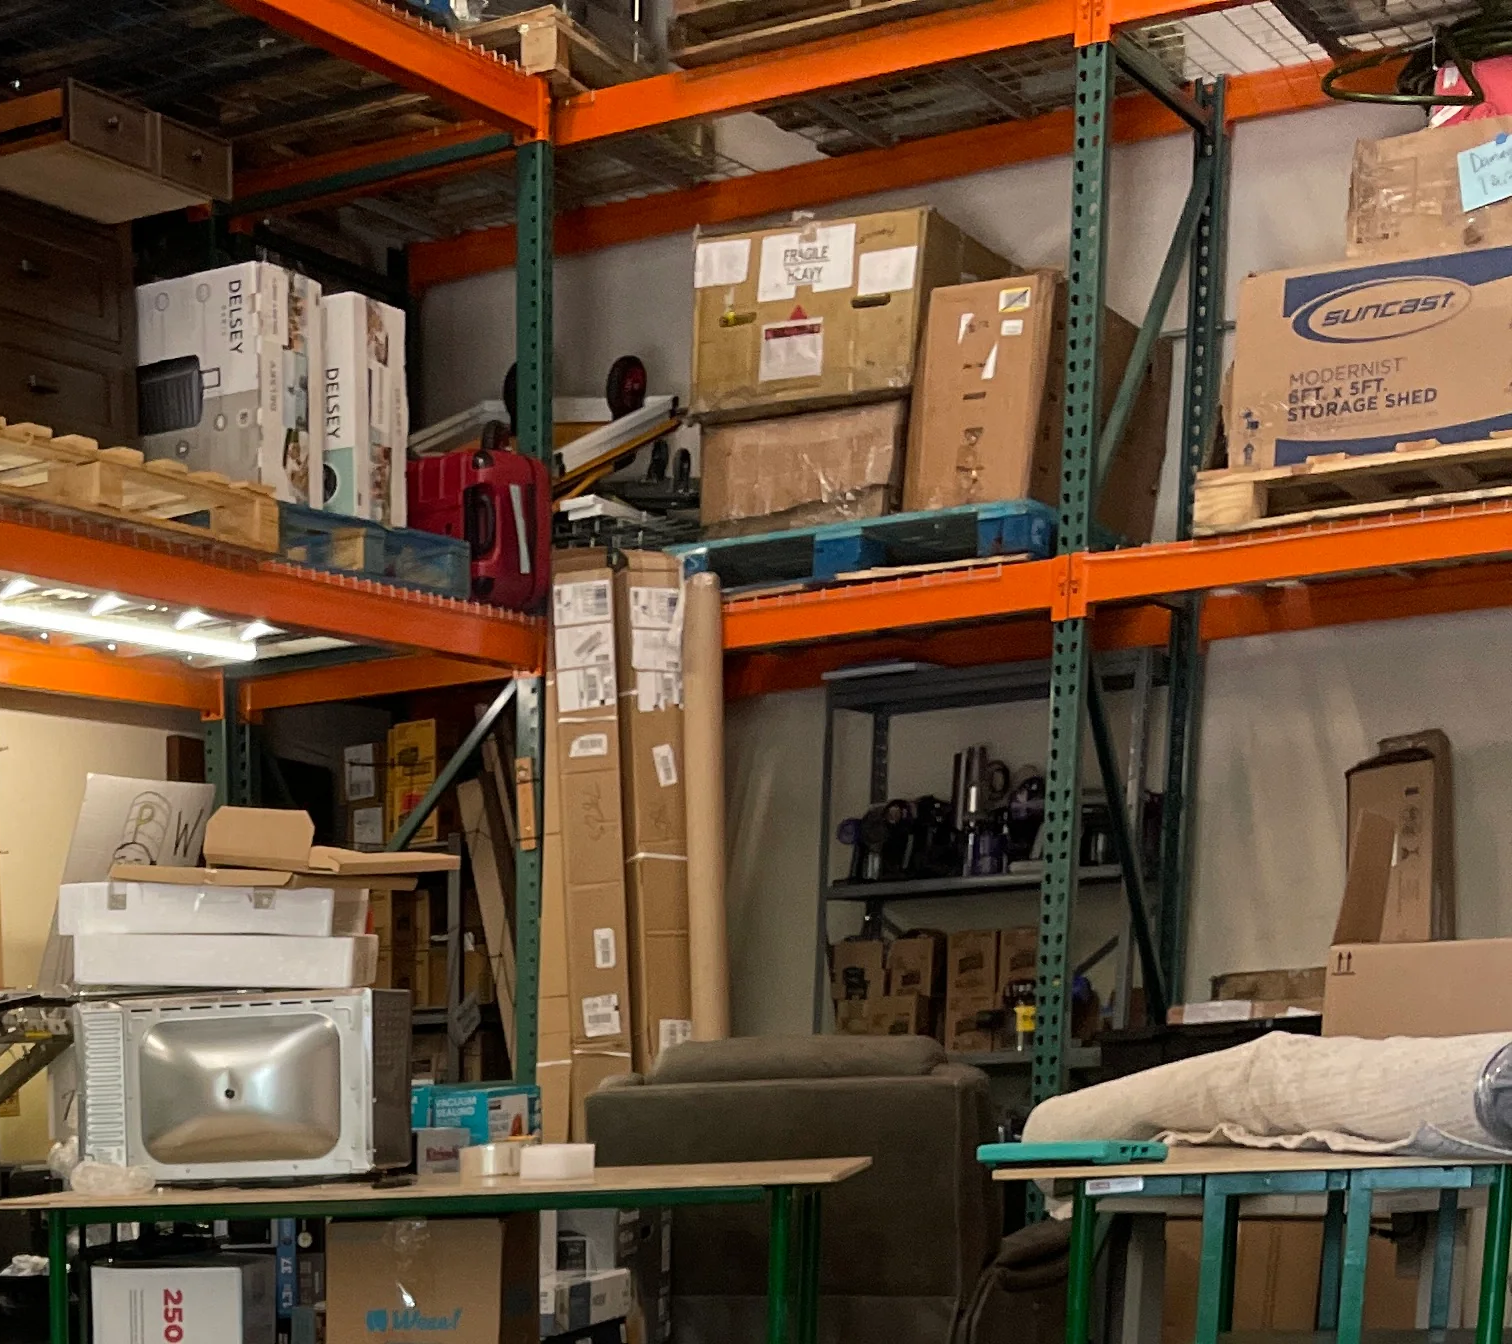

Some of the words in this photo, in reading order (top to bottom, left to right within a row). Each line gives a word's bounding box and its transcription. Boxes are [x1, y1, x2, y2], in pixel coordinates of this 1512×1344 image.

[784, 246, 830, 263] FRAGILE
[228, 279, 244, 354] DELSEY
[1289, 357, 1404, 388] MODERNIST
[325, 367, 342, 439] DELSEY
[1287, 395, 1378, 422] STORAGE
[1384, 387, 1438, 409] SHED
